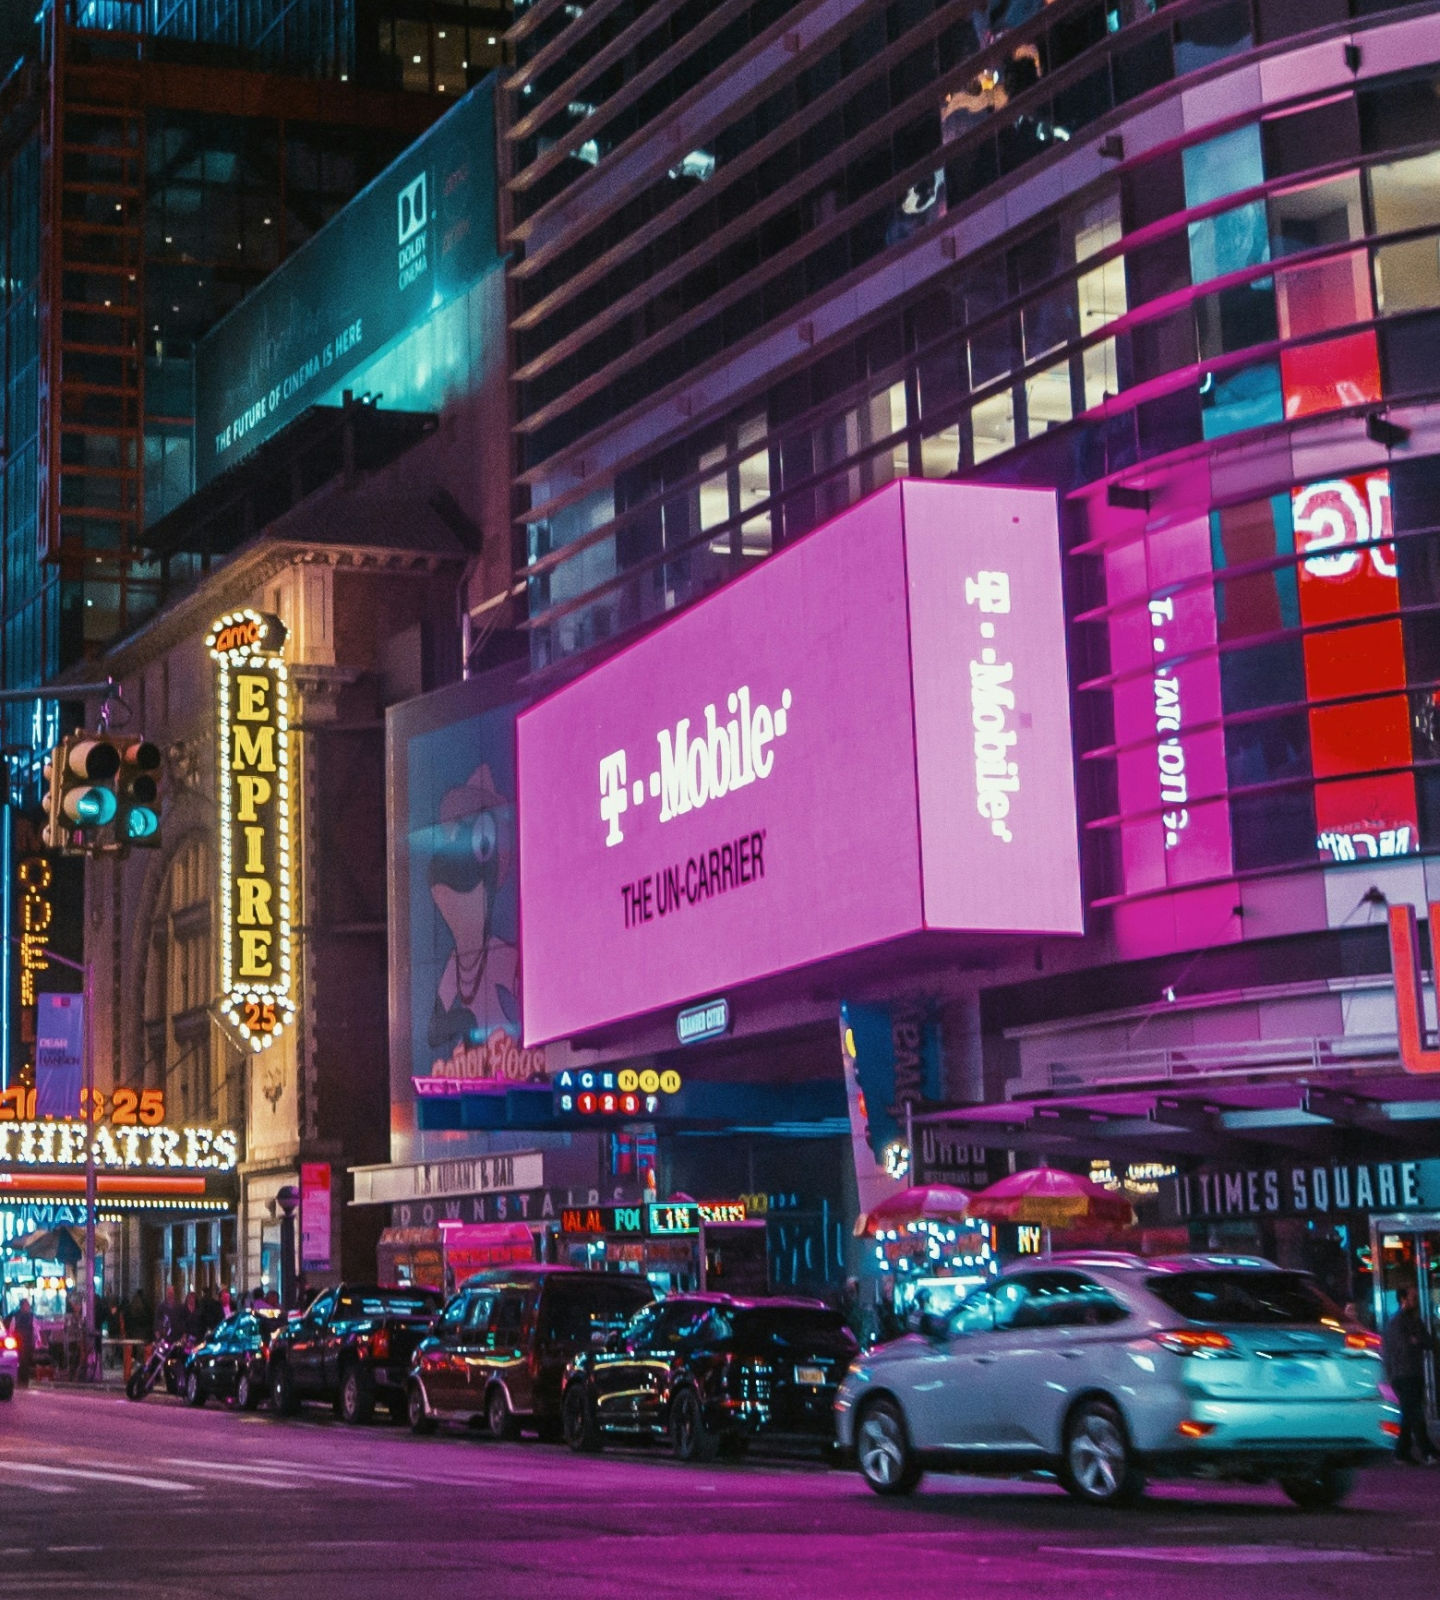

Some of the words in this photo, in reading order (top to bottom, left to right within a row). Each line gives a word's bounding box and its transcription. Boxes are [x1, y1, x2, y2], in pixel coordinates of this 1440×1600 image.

[398, 231, 428, 269] DOLBY
[398, 254, 428, 291] CINEMA
[215, 425, 232, 454] THE
[233, 395, 266, 441] FUTURE
[268, 386, 282, 409] OF
[282, 355, 320, 399] CINEMA
[322, 347, 333, 368] IS
[335, 318, 363, 358] HERE
[232, 674, 277, 978] EMPIRE
[621, 874, 653, 930] THE
[245, 1003, 276, 1032] 25
[111, 1088, 165, 1126] 25
[1199, 1169, 1279, 1214] TIMES
[1291, 1162, 1421, 1213] SQUARE
[1017, 1225, 1041, 1254] NY
